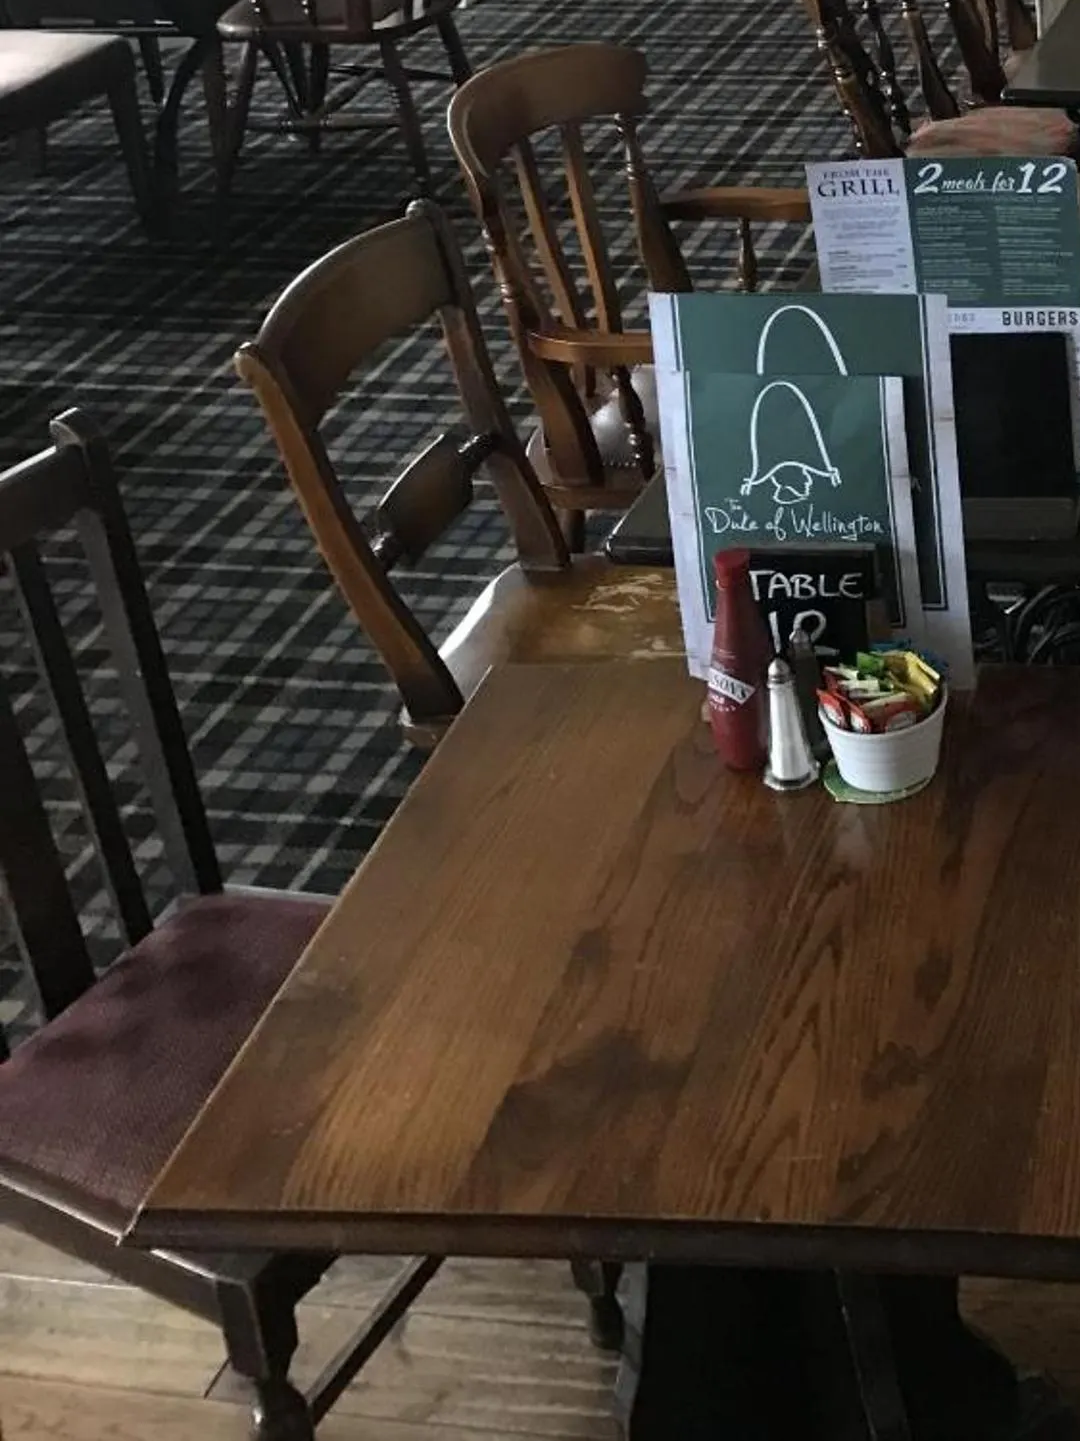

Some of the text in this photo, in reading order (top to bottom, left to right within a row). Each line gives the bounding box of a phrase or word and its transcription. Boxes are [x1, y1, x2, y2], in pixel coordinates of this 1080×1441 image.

[823, 167, 890, 179] FROM THE
[914, 162, 1067, 195] 2 meals for 12
[817, 178, 900, 198] GRILL
[1002, 311, 1079, 327] BURGERS
[704, 503, 885, 541] Duke of Wellington
[748, 569, 863, 602] TABLE
